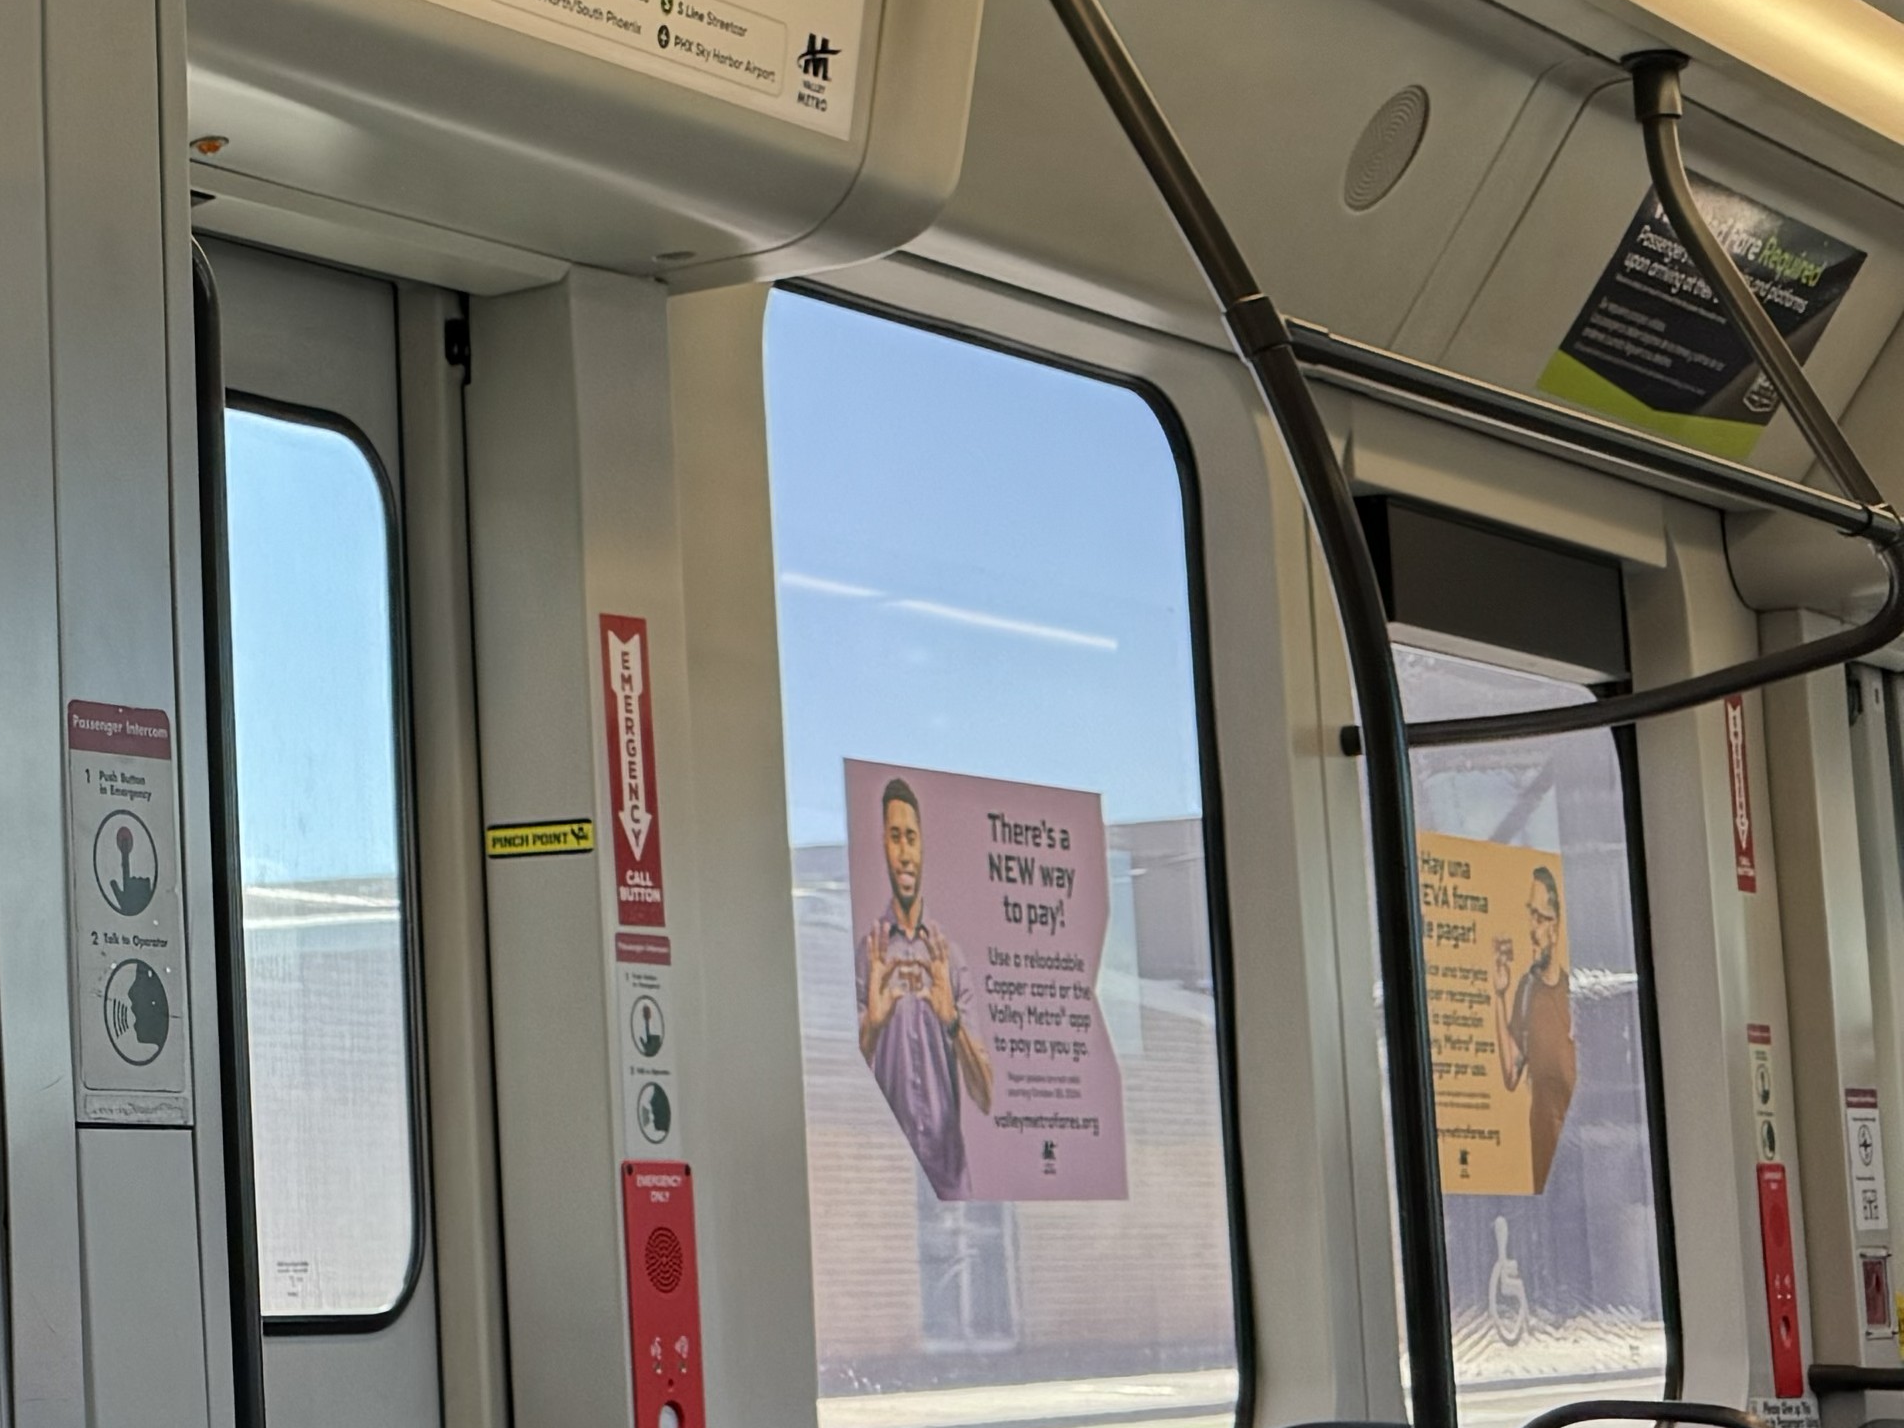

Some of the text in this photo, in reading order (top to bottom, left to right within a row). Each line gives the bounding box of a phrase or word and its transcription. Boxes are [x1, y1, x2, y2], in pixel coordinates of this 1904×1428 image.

[1758, 235, 1829, 288] Required
[71, 713, 169, 740] Passenger Intercom
[620, 649, 643, 849] EMERGENCY
[85, 767, 92, 785] 1
[491, 831, 569, 849] PINCH POINT
[986, 811, 1072, 851] There's a
[624, 868, 654, 887] CALL
[987, 851, 1076, 900] NEW way
[619, 885, 662, 904] BUTTON
[1002, 893, 1067, 937] to pay!
[91, 930, 99, 947] 2
[988, 945, 1012, 967] Use
[985, 973, 1028, 1003] Copper
[1072, 981, 1093, 1002] the
